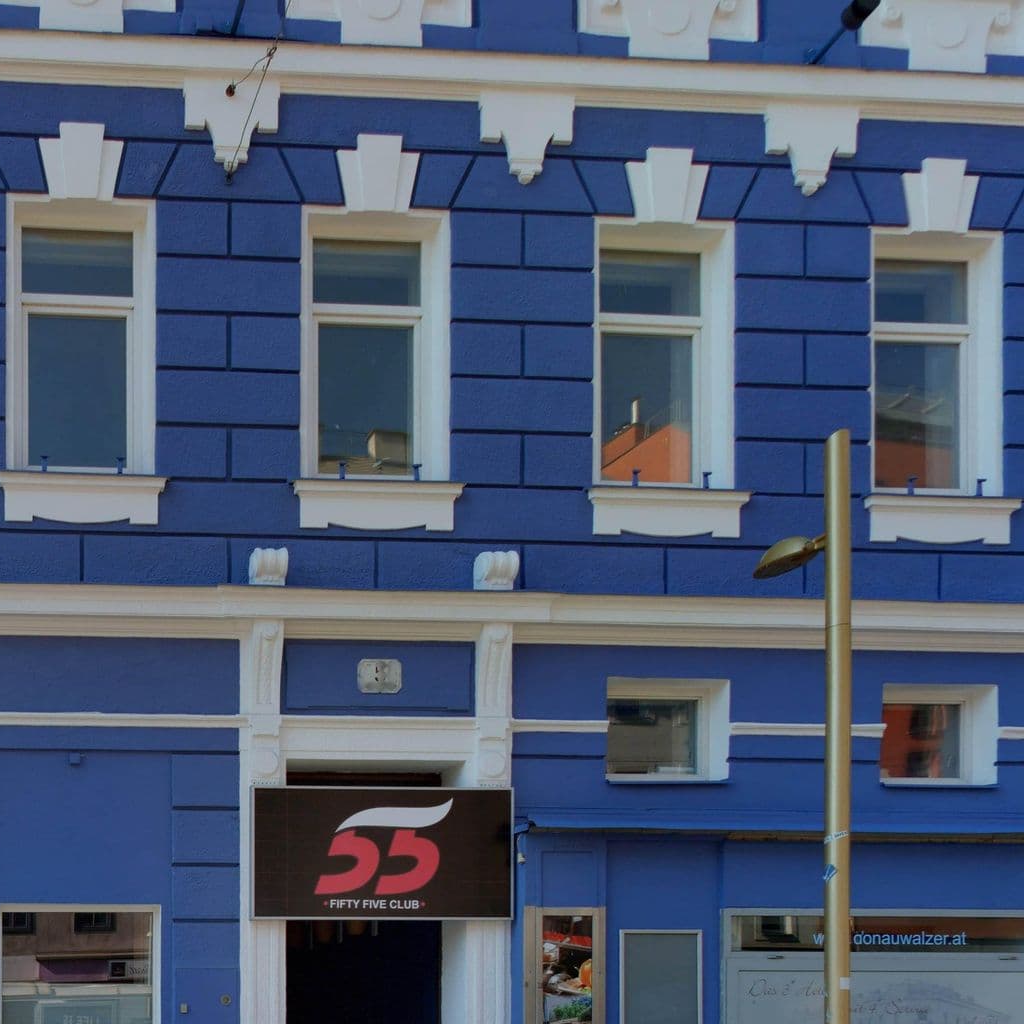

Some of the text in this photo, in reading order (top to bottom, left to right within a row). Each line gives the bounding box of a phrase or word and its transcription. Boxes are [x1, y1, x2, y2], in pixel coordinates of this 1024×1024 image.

[314, 798, 454, 895] 55
[329, 899, 420, 910] FIFTY FIVE CLUB
[812, 930, 967, 946] wdonauwalzer.at
